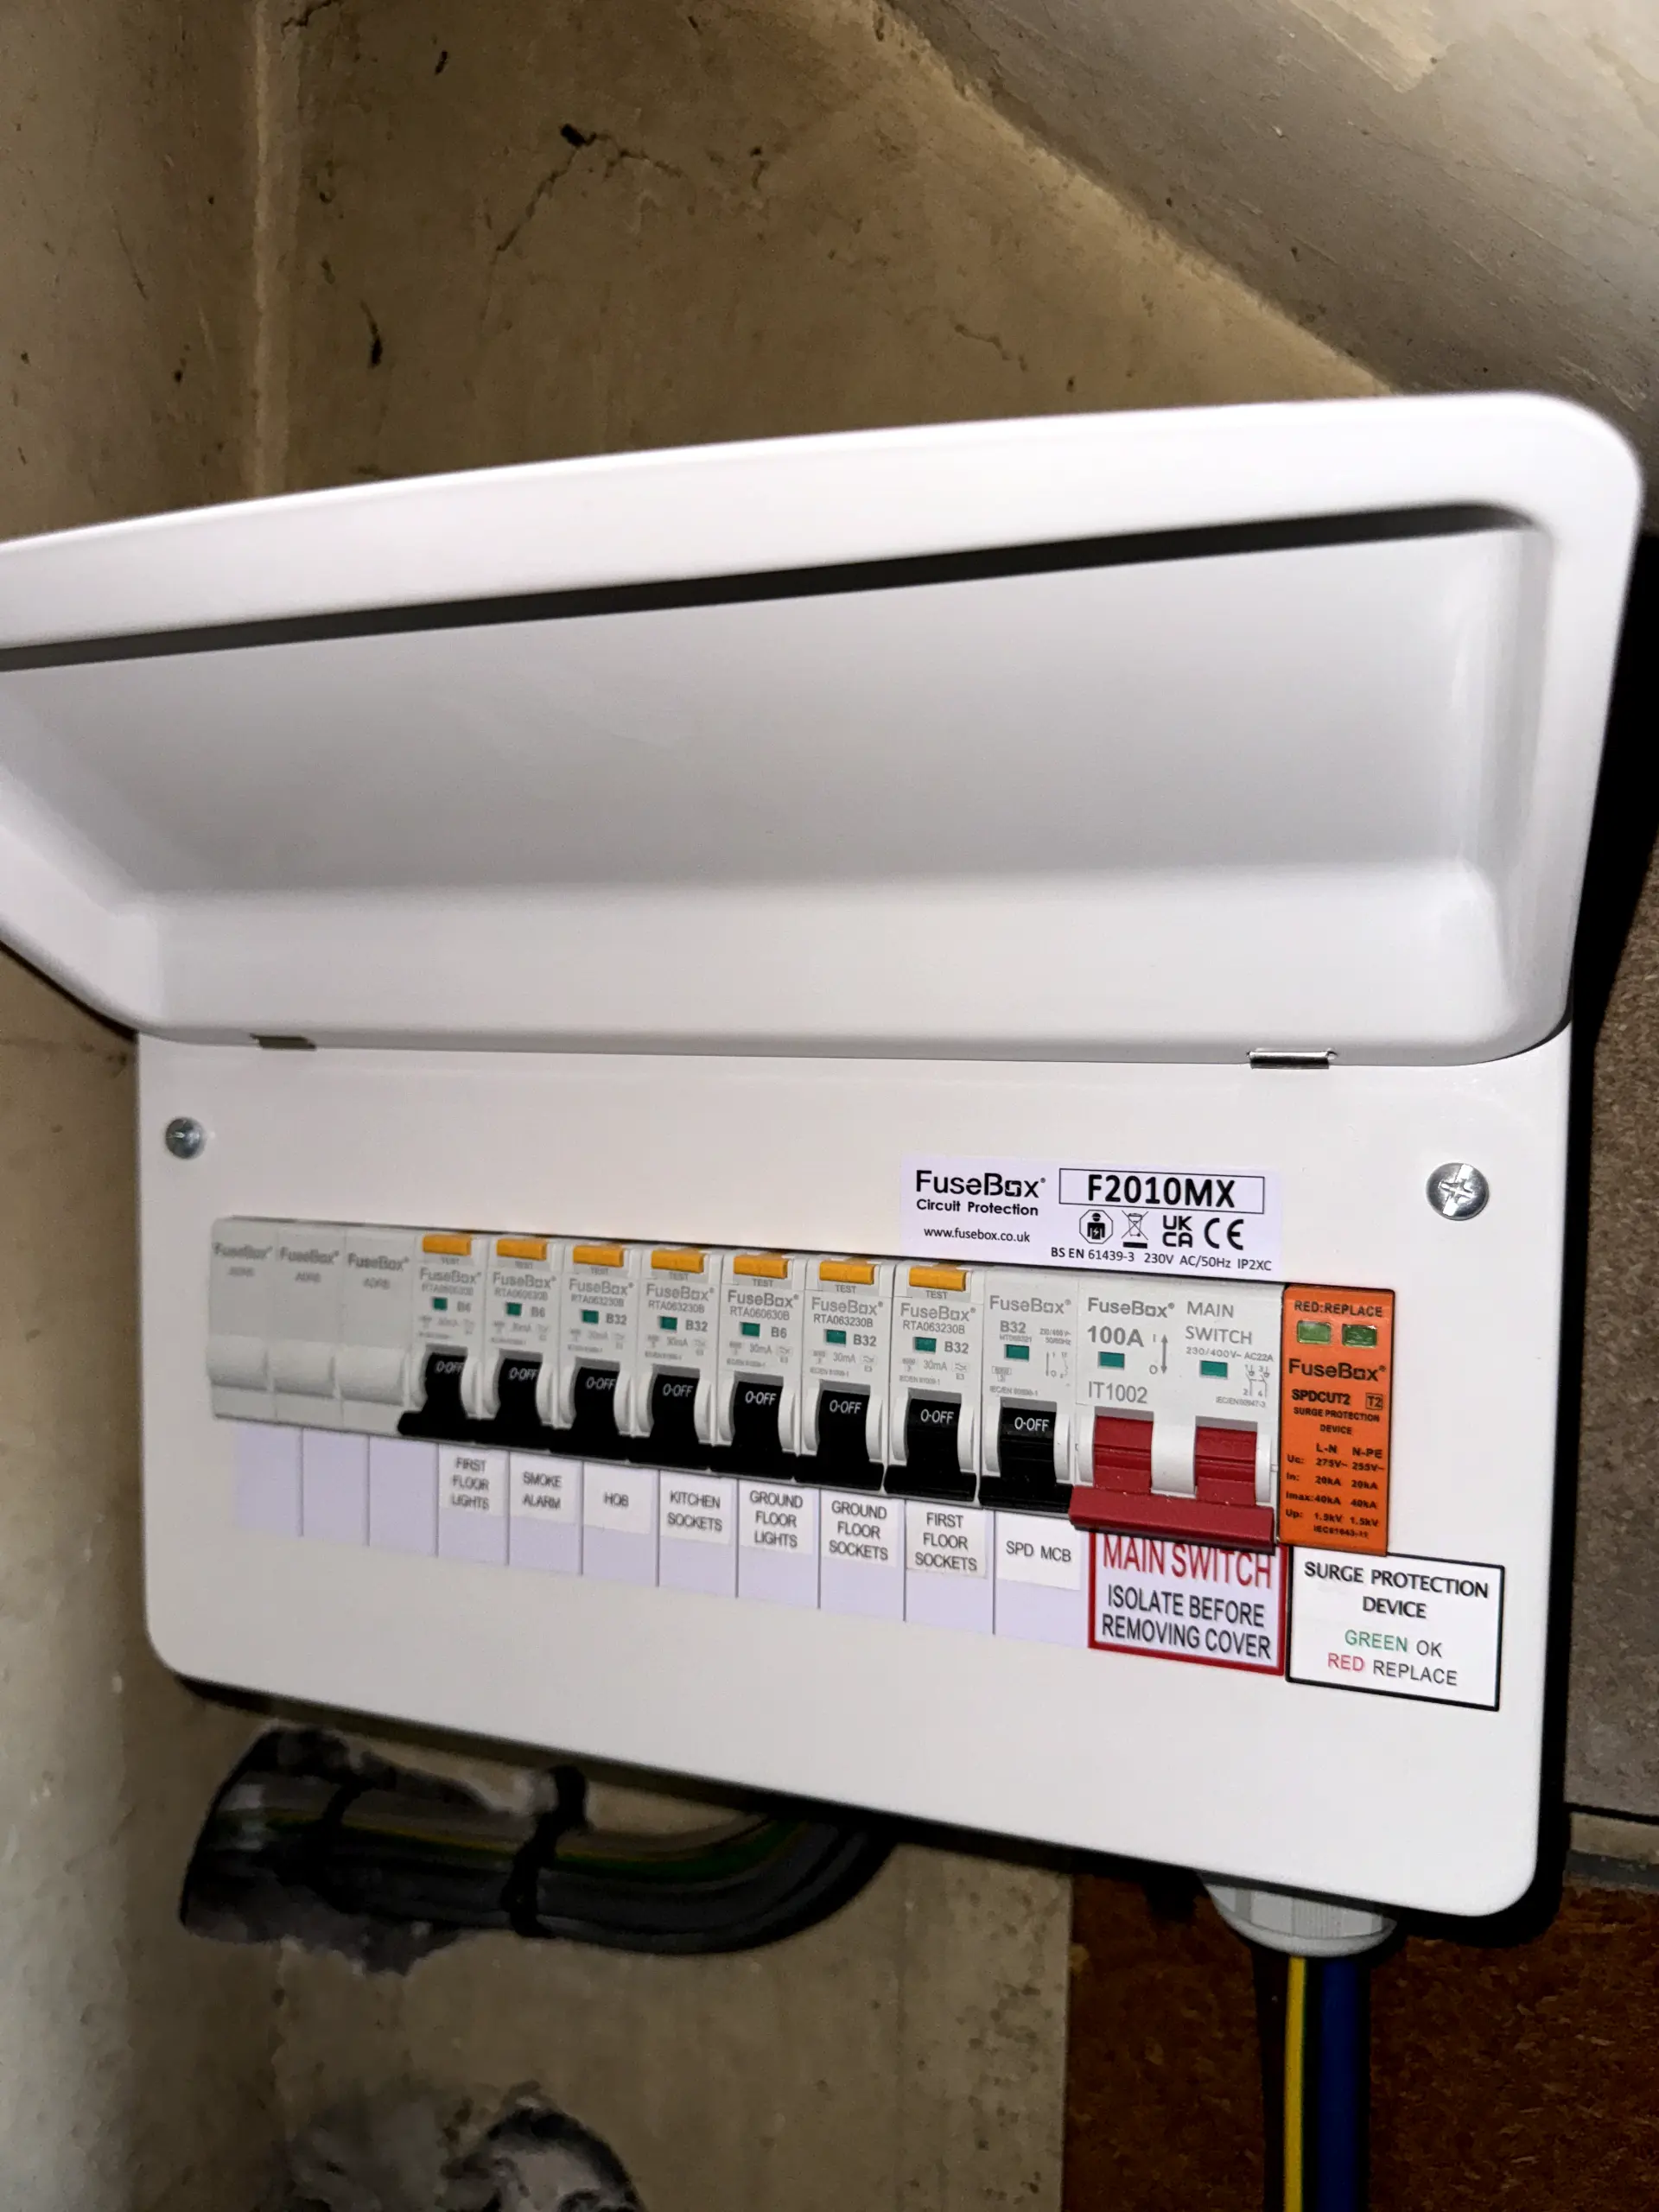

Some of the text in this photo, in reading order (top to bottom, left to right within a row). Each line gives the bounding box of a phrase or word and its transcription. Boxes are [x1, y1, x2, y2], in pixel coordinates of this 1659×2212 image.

[1087, 1173, 1236, 1208] F2010MX
[916, 1198, 1039, 1217] Circuit Protection
[924, 1227, 1031, 1243] www.fusebox.co.uk
[1051, 1246, 1273, 1272] BS EN 61439-3 230V AC/50Hz IP2XC
[589, 1267, 609, 1276] TEST
[669, 1272, 690, 1281] TEST
[752, 1278, 775, 1288] TEST
[835, 1284, 857, 1294] TEST
[925, 1289, 948, 1300] TEST
[531, 1306, 546, 1319] B6
[648, 1300, 706, 1314] RTA063230B
[729, 1306, 791, 1322] RTA060630B
[1186, 1300, 1234, 1319] MAIN
[1294, 1300, 1383, 1318] RED:REPLACE
[606, 1313, 627, 1326] B32
[685, 1319, 709, 1332] B32
[813, 1313, 874, 1329] RTA063230B
[902, 1319, 966, 1335] RTA063230B
[1000, 1319, 1027, 1335] B32
[771, 1325, 788, 1339] B6
[1087, 1325, 1145, 1348] 100A
[1185, 1325, 1253, 1345] SWITCH
[749, 1343, 772, 1355] 30mA
[853, 1334, 878, 1348] B32
[944, 1340, 969, 1355] B32
[833, 1351, 856, 1364] 30mA
[923, 1359, 948, 1371] 30mA
[1244, 1351, 1274, 1363] AC22A
[1089, 1381, 1147, 1404] IT1002
[1291, 1389, 1351, 1406] SPDCUT2
[1367, 1395, 1383, 1408] T2
[1293, 1406, 1380, 1422] SURGE PROTECTION
[1319, 1424, 1352, 1435] DEVICE
[1315, 1442, 1382, 1459] L-N N-PE
[455, 1456, 486, 1472] FIRST
[452, 1474, 490, 1491] FLOOR
[523, 1471, 563, 1489] SMOKE
[1314, 1475, 1342, 1487] 20kA
[1351, 1479, 1378, 1491] 20kA
[451, 1493, 490, 1510] LIGHTS
[523, 1493, 561, 1510] ALARM
[604, 1491, 629, 1508] HOB
[670, 1490, 721, 1510] KITCHEN
[749, 1490, 804, 1510] GROUND
[1286, 1491, 1377, 1510] Imax: 40kA 40kA
[831, 1499, 887, 1521] GROUND
[1285, 1508, 1303, 1519] Up:
[1350, 1516, 1379, 1528] 1.5kV
[667, 1512, 722, 1533] SOCKETS
[755, 1510, 797, 1529] FLOOR
[926, 1512, 964, 1529] FIRST
[837, 1520, 880, 1540] FLOOR
[754, 1530, 798, 1548] LIGHTS
[923, 1532, 969, 1551] FLOOR
[829, 1540, 888, 1561] SOCKETS
[1006, 1541, 1071, 1562] SPD MCB
[915, 1552, 977, 1573] SOCKETS
[1103, 1535, 1273, 1589] MAIN SWITCH
[1304, 1560, 1488, 1599] SURGE PROTECTION
[1108, 1583, 1265, 1628] ISOLATE BEFORE
[1362, 1596, 1427, 1618] DEVICE
[1102, 1612, 1272, 1660] REMOVING COVER
[1344, 1629, 1442, 1658] GREEN OK
[1327, 1652, 1458, 1686] RED REPLACE
